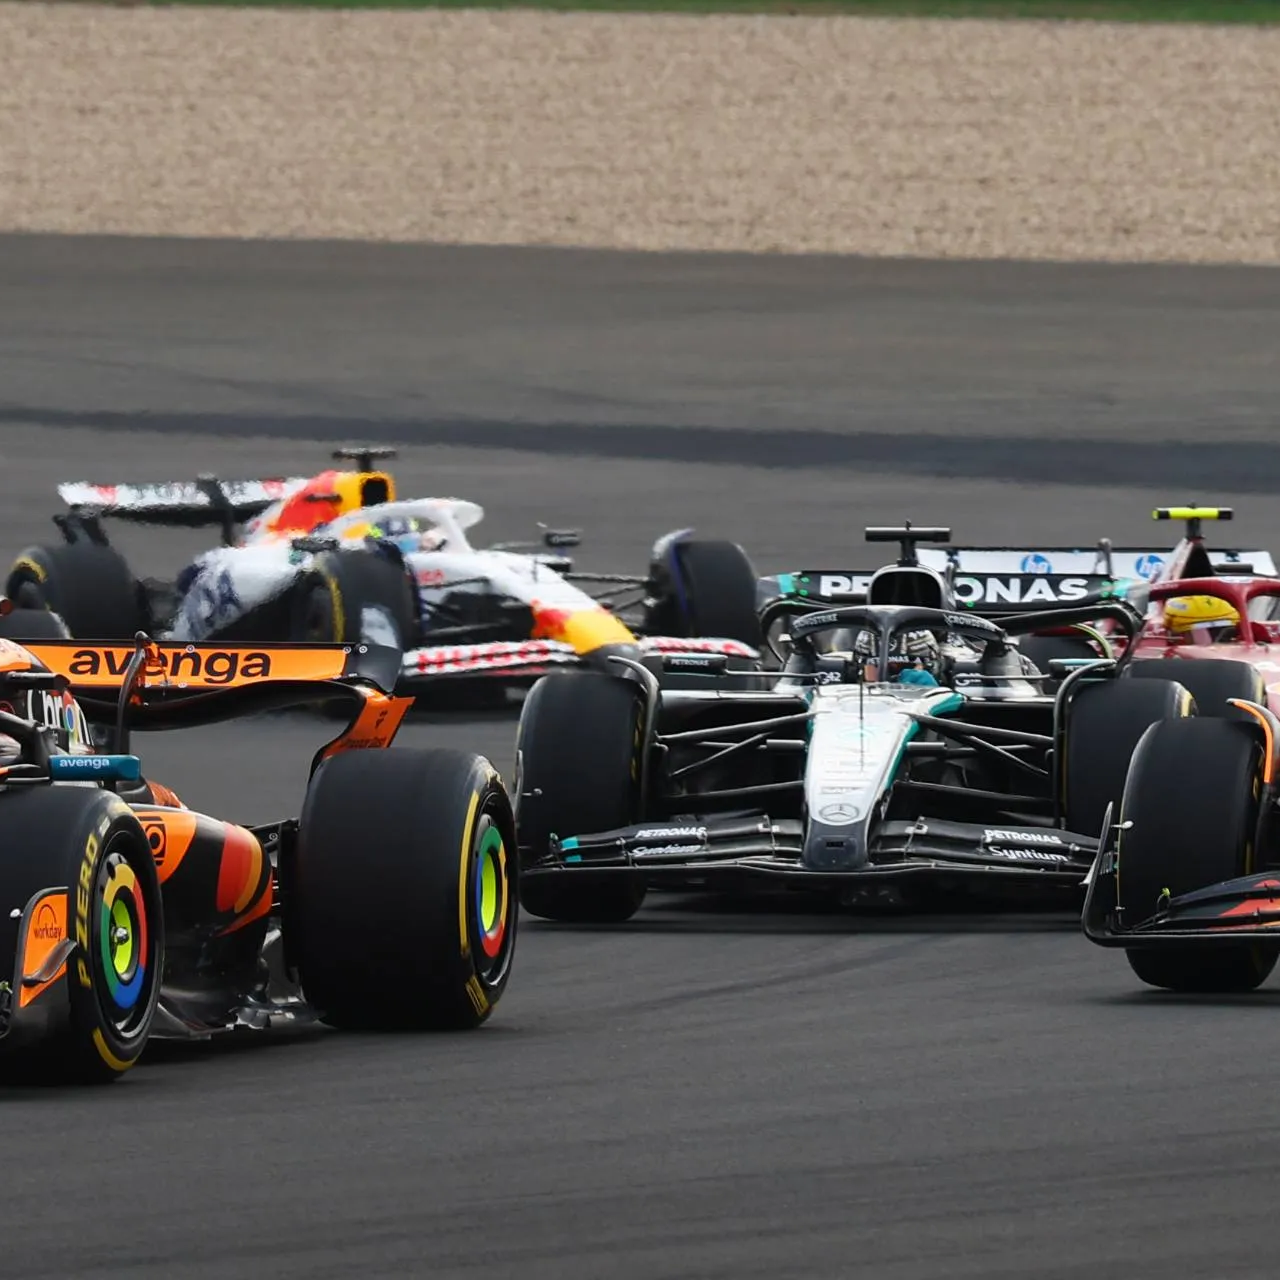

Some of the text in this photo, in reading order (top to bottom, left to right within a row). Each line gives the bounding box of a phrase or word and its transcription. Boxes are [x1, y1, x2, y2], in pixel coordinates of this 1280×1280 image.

[820, 575, 1089, 603] PEONAS
[69, 650, 271, 683] avenga
[671, 658, 709, 666] PETRONAS
[59, 756, 110, 769] avenga
[636, 826, 707, 839] PETRONAS
[984, 829, 1062, 844] PETRONAS
[989, 846, 1068, 862] Syntium
[76, 831, 98, 953] ZERO
[34, 923, 61, 941] workday
